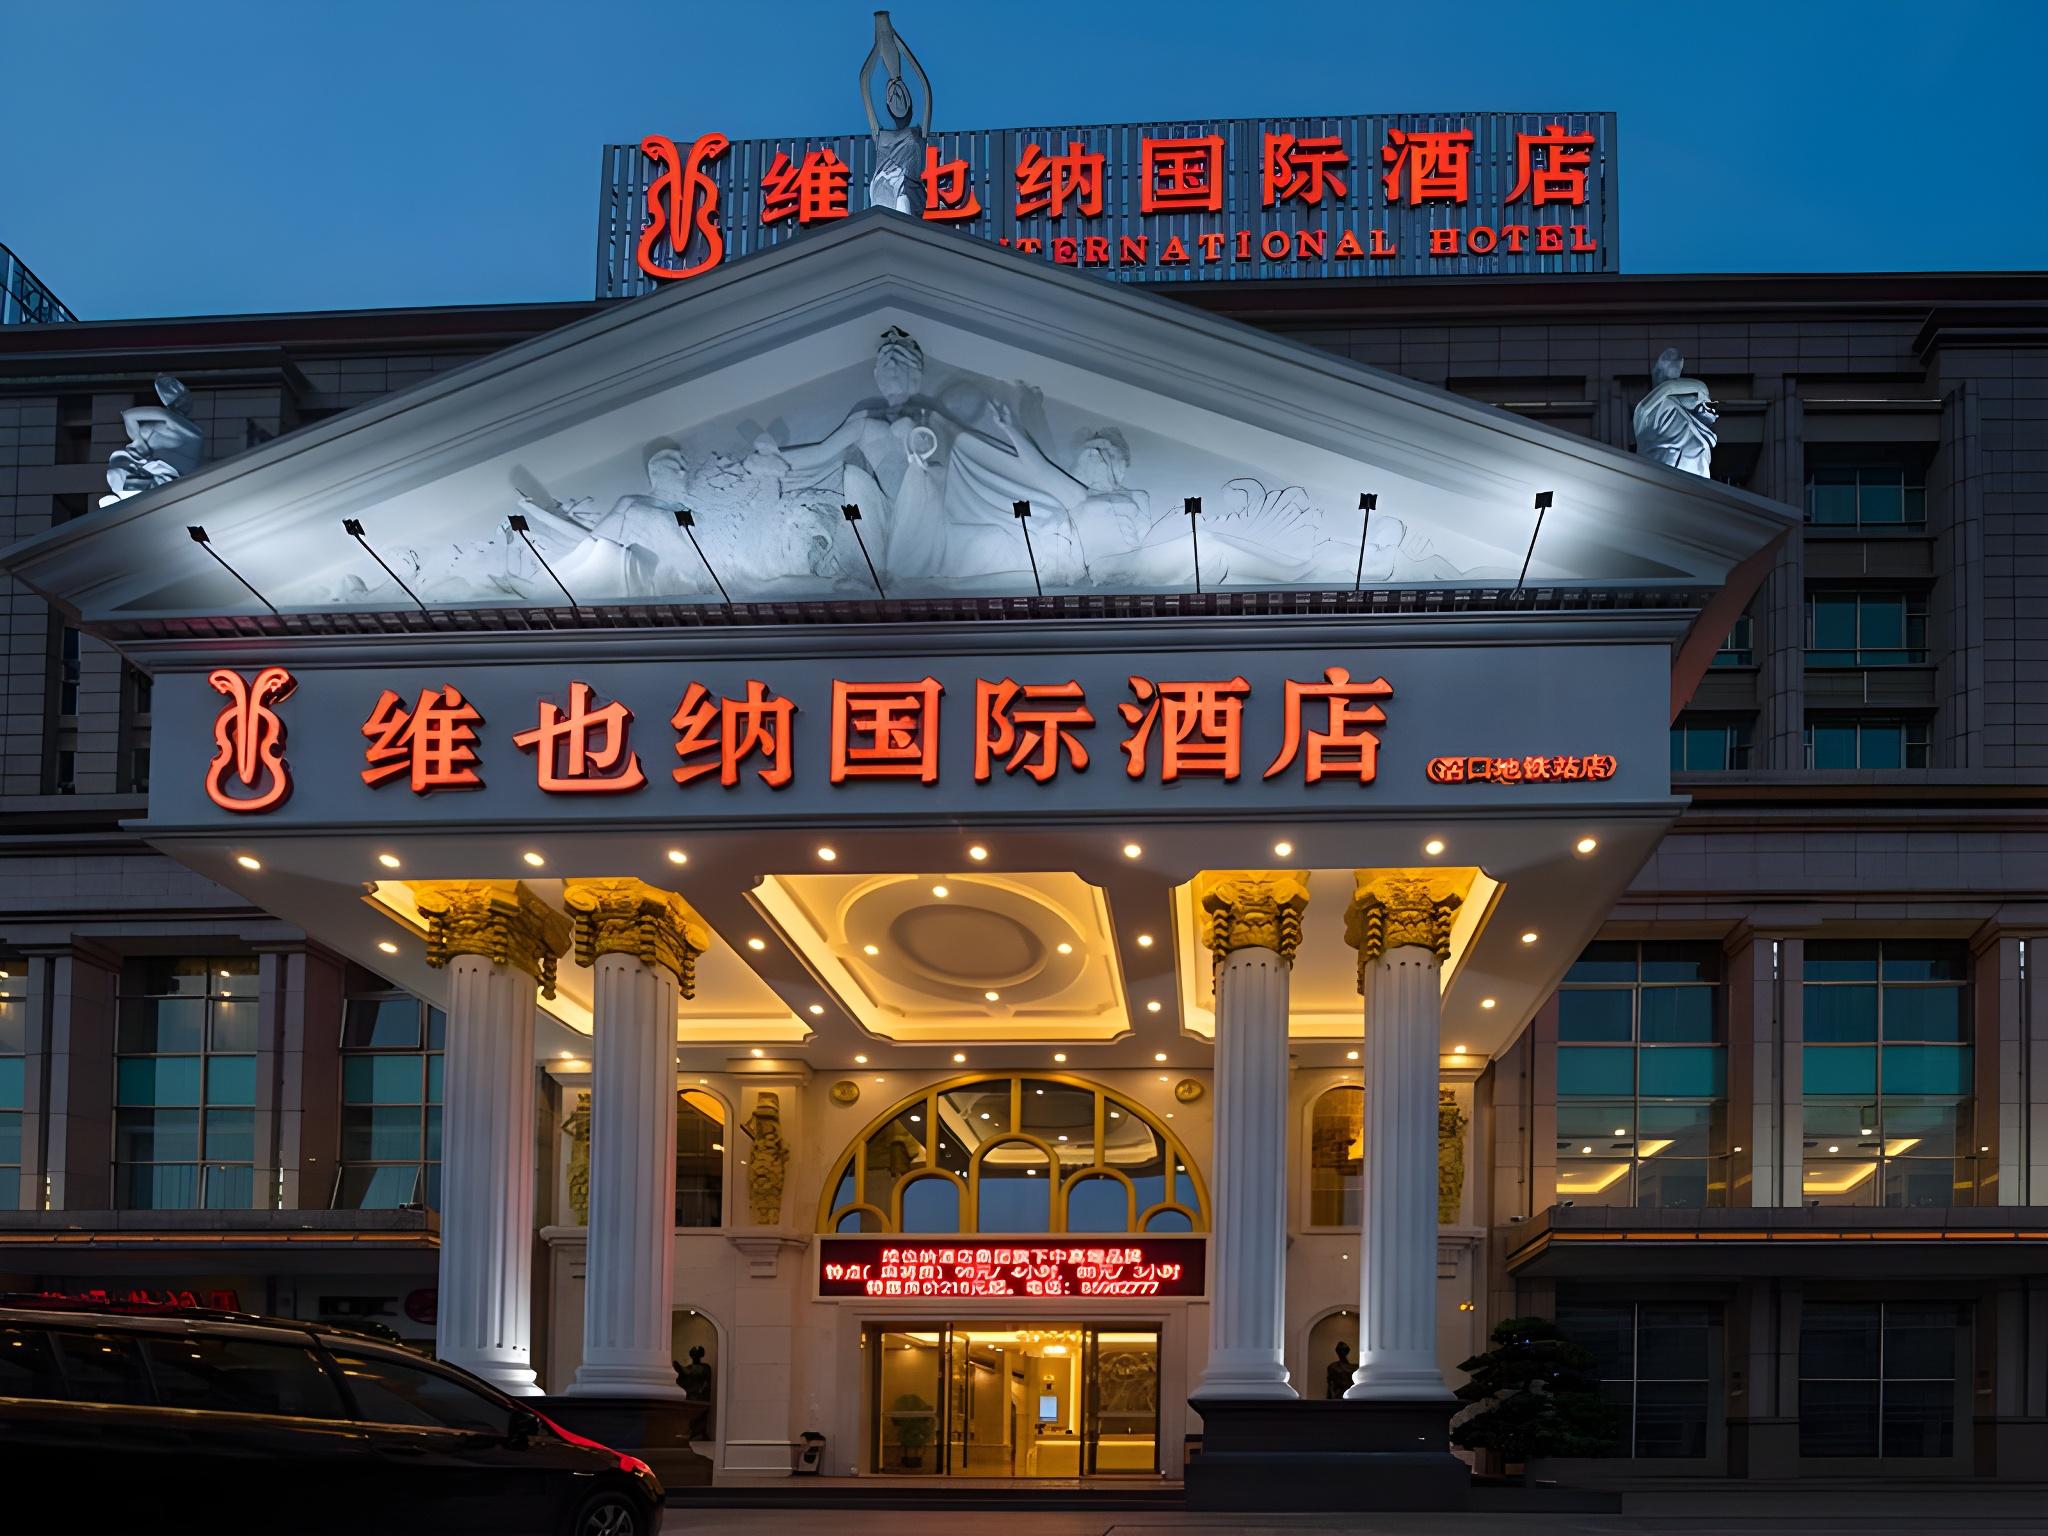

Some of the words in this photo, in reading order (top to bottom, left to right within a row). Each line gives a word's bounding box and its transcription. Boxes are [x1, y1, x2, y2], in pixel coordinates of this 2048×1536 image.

[762, 125, 1595, 223] 维也纳国际酒店
[999, 229, 1396, 264] TERNATIONAL
[1430, 224, 1597, 255] HOTEL
[360, 666, 1394, 793] 维也纳国际酒店
